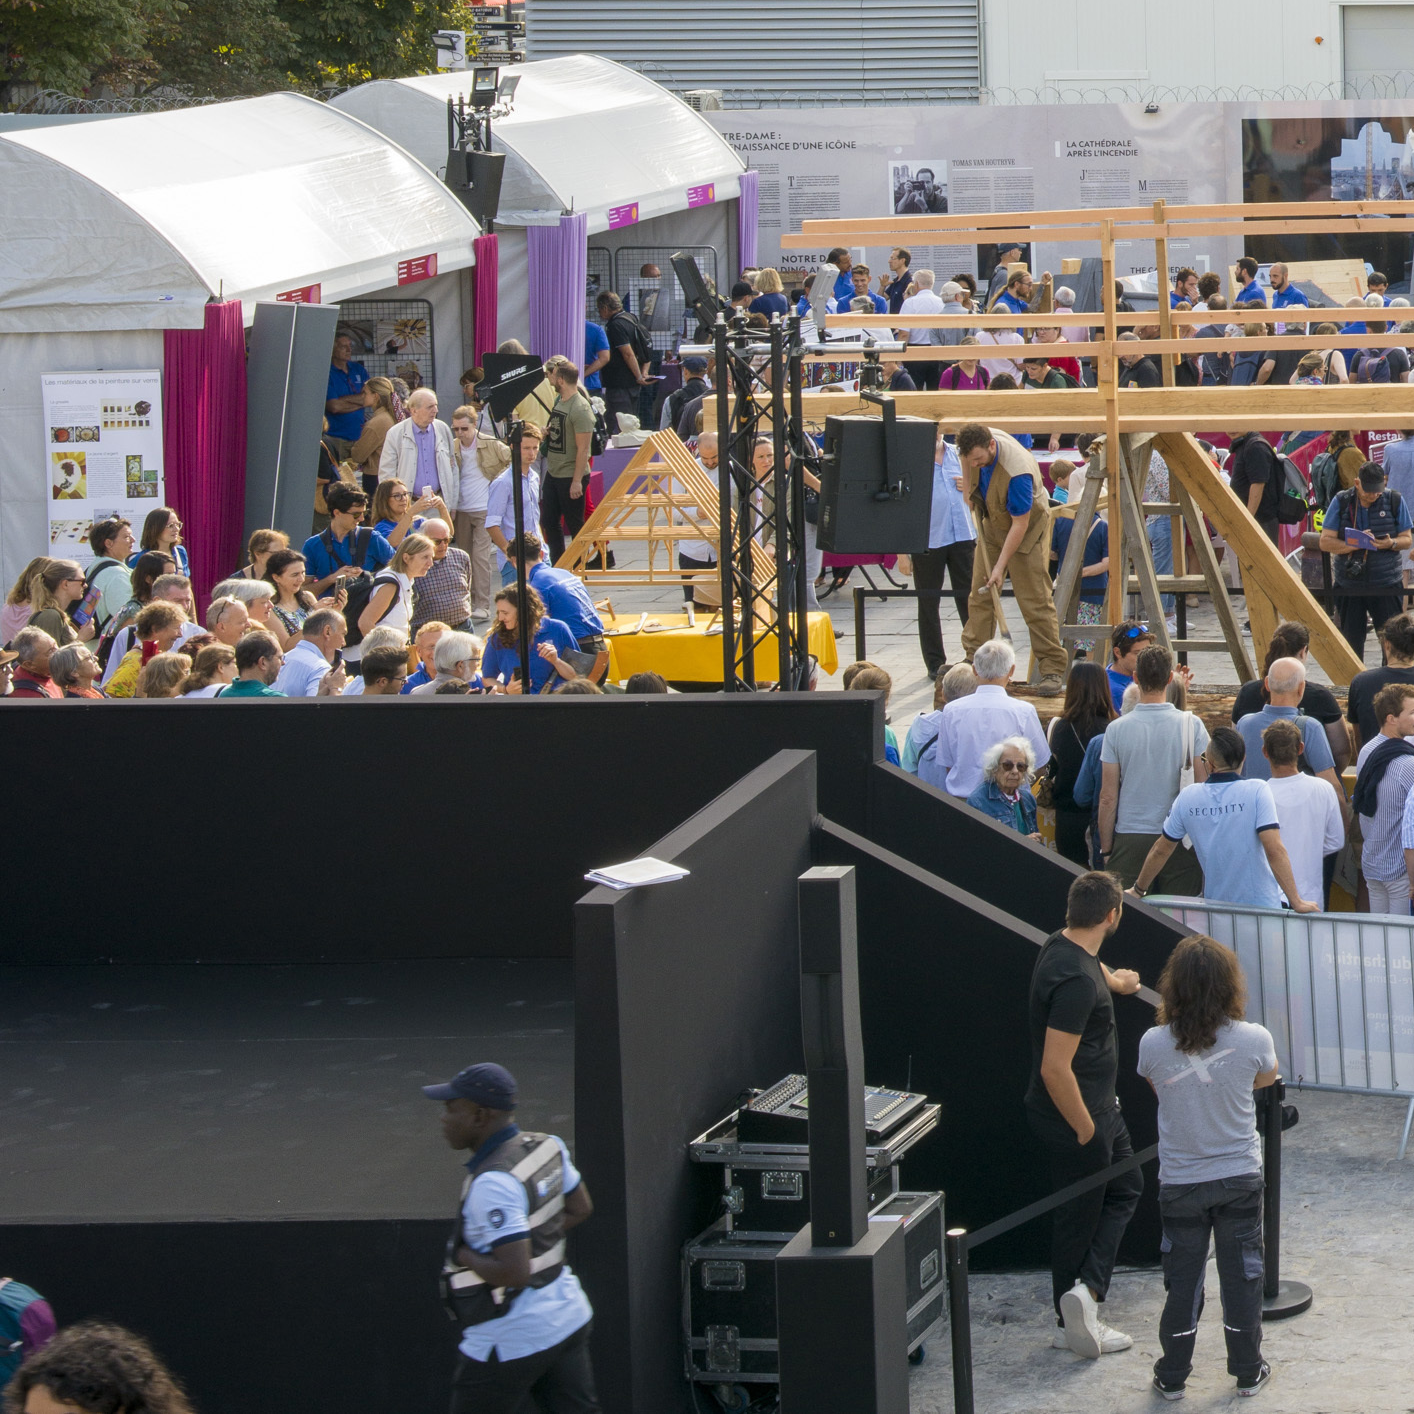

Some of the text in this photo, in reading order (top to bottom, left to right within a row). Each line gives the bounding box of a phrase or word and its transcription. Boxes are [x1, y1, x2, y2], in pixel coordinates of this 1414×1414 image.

[722, 132, 776, 141] TRE-DAME
[729, 139, 857, 151] ENAISSANCE D'UNE ICÔNE
[1078, 139, 1132, 147] CATHÉDRALE
[1067, 149, 1092, 157] APRÈS
[782, 255, 817, 263] NOTRE
[501, 365, 527, 380] SHURE
[1189, 803, 1245, 816] SECURITY
